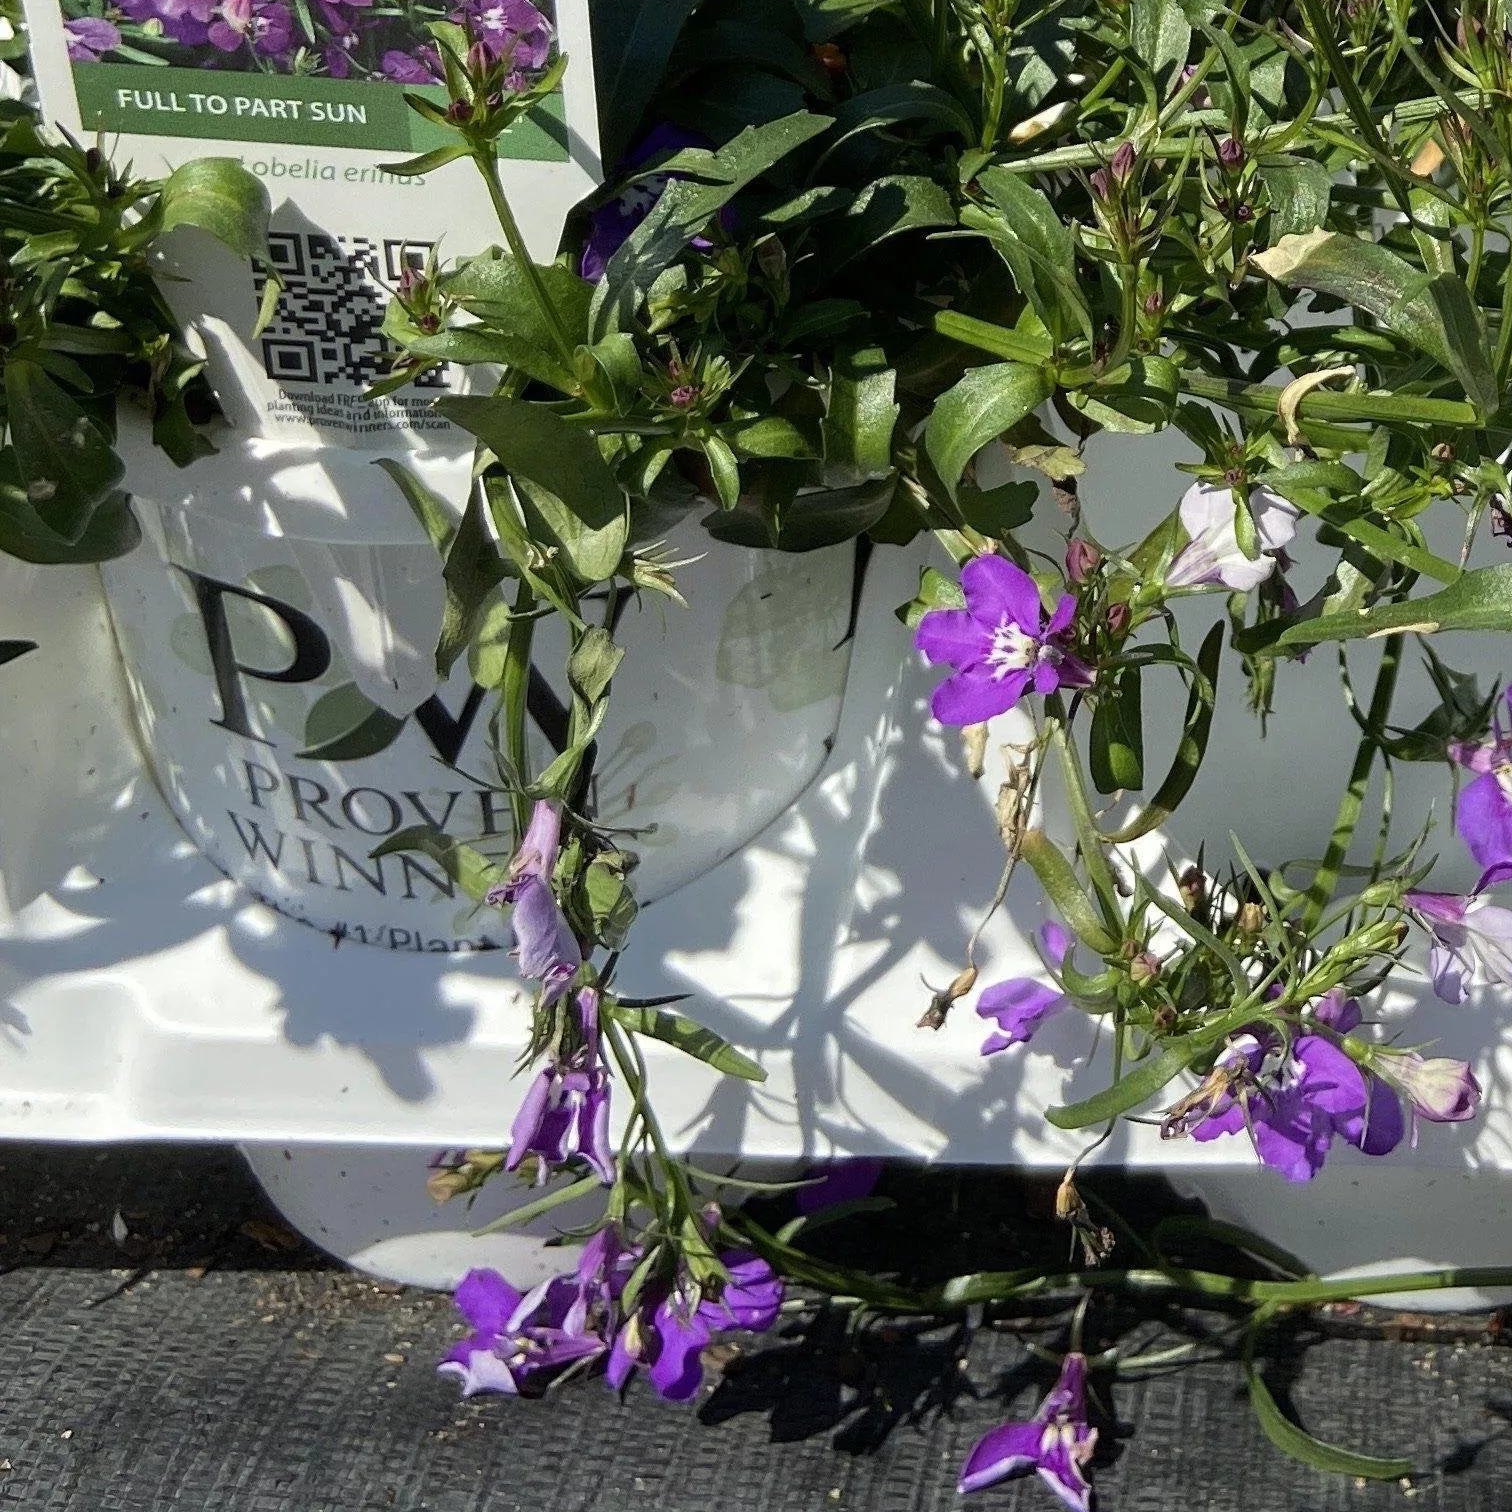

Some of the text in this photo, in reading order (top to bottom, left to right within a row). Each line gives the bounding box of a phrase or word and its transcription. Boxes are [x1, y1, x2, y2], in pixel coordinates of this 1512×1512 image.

[117, 89, 367, 124] FULL TO PART SUN
[393, 395, 408, 407] for
